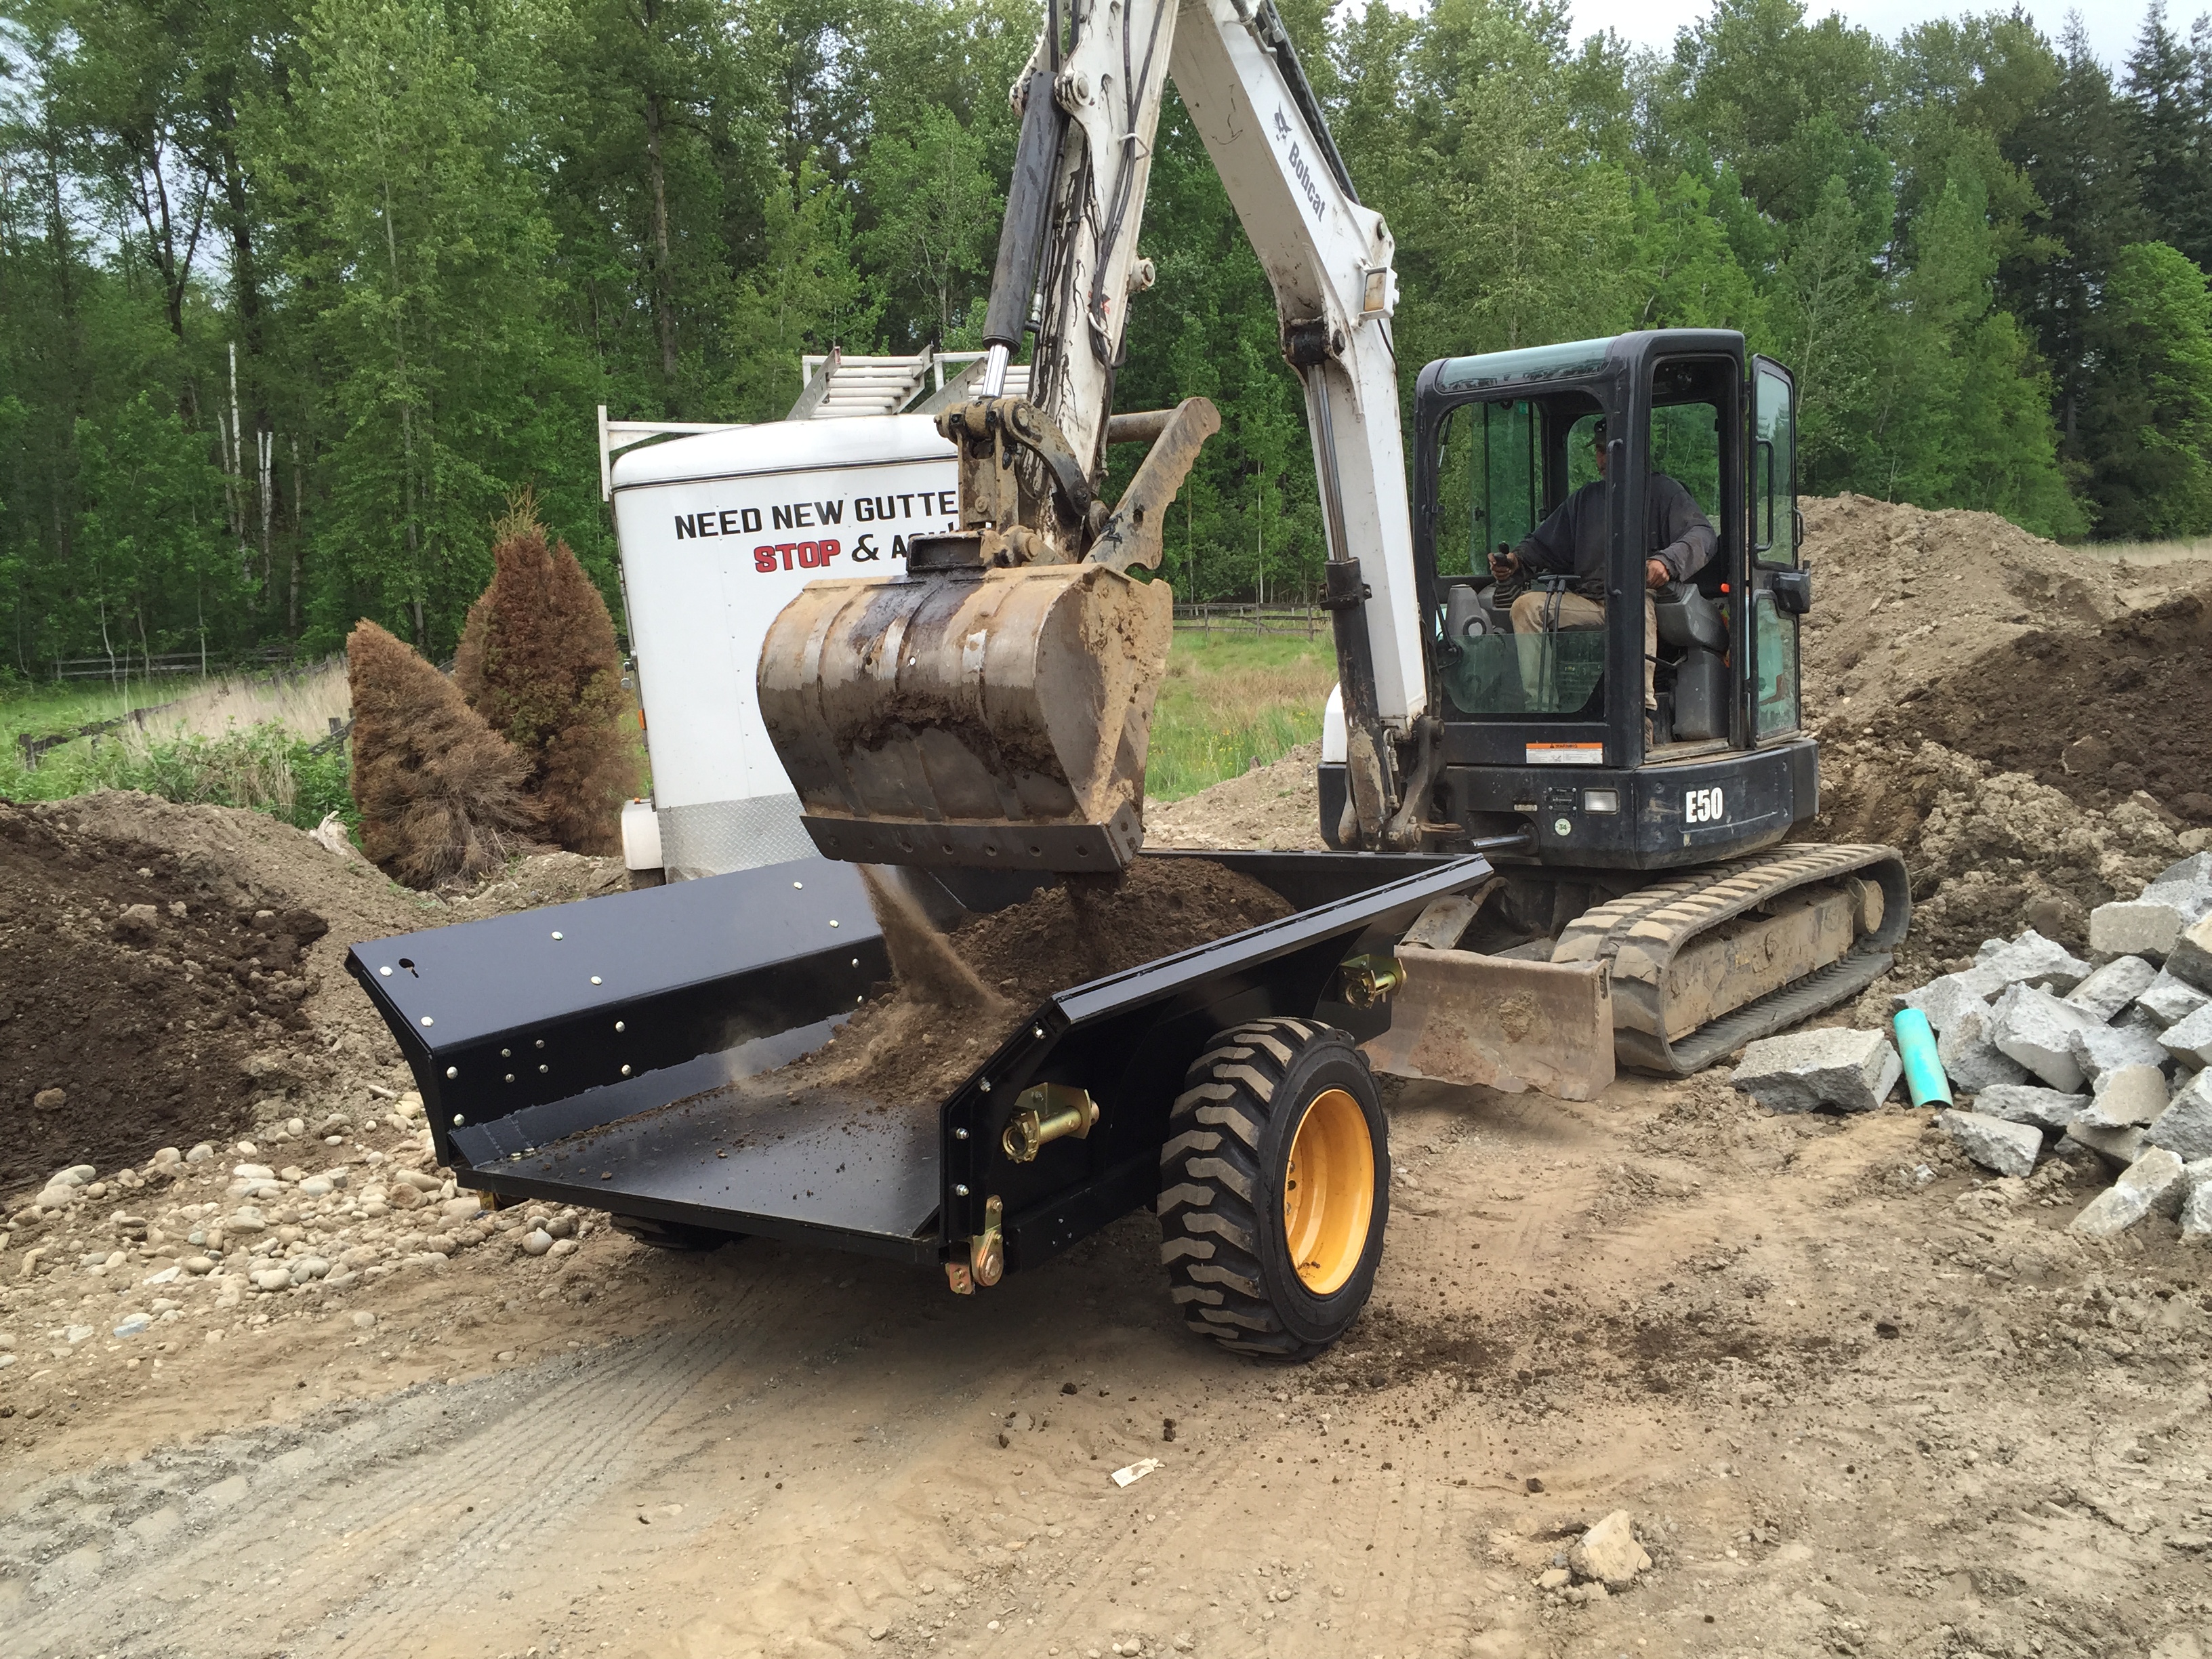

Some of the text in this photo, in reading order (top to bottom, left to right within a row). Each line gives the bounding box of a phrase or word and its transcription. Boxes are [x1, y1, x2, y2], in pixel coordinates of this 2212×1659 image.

[1289, 140, 1326, 222] Bobcat
[674, 507, 762, 540] NEED
[772, 499, 844, 530] NEW
[754, 539, 841, 573] STOP
[851, 533, 880, 562] &
[1685, 787, 1723, 823] E50
